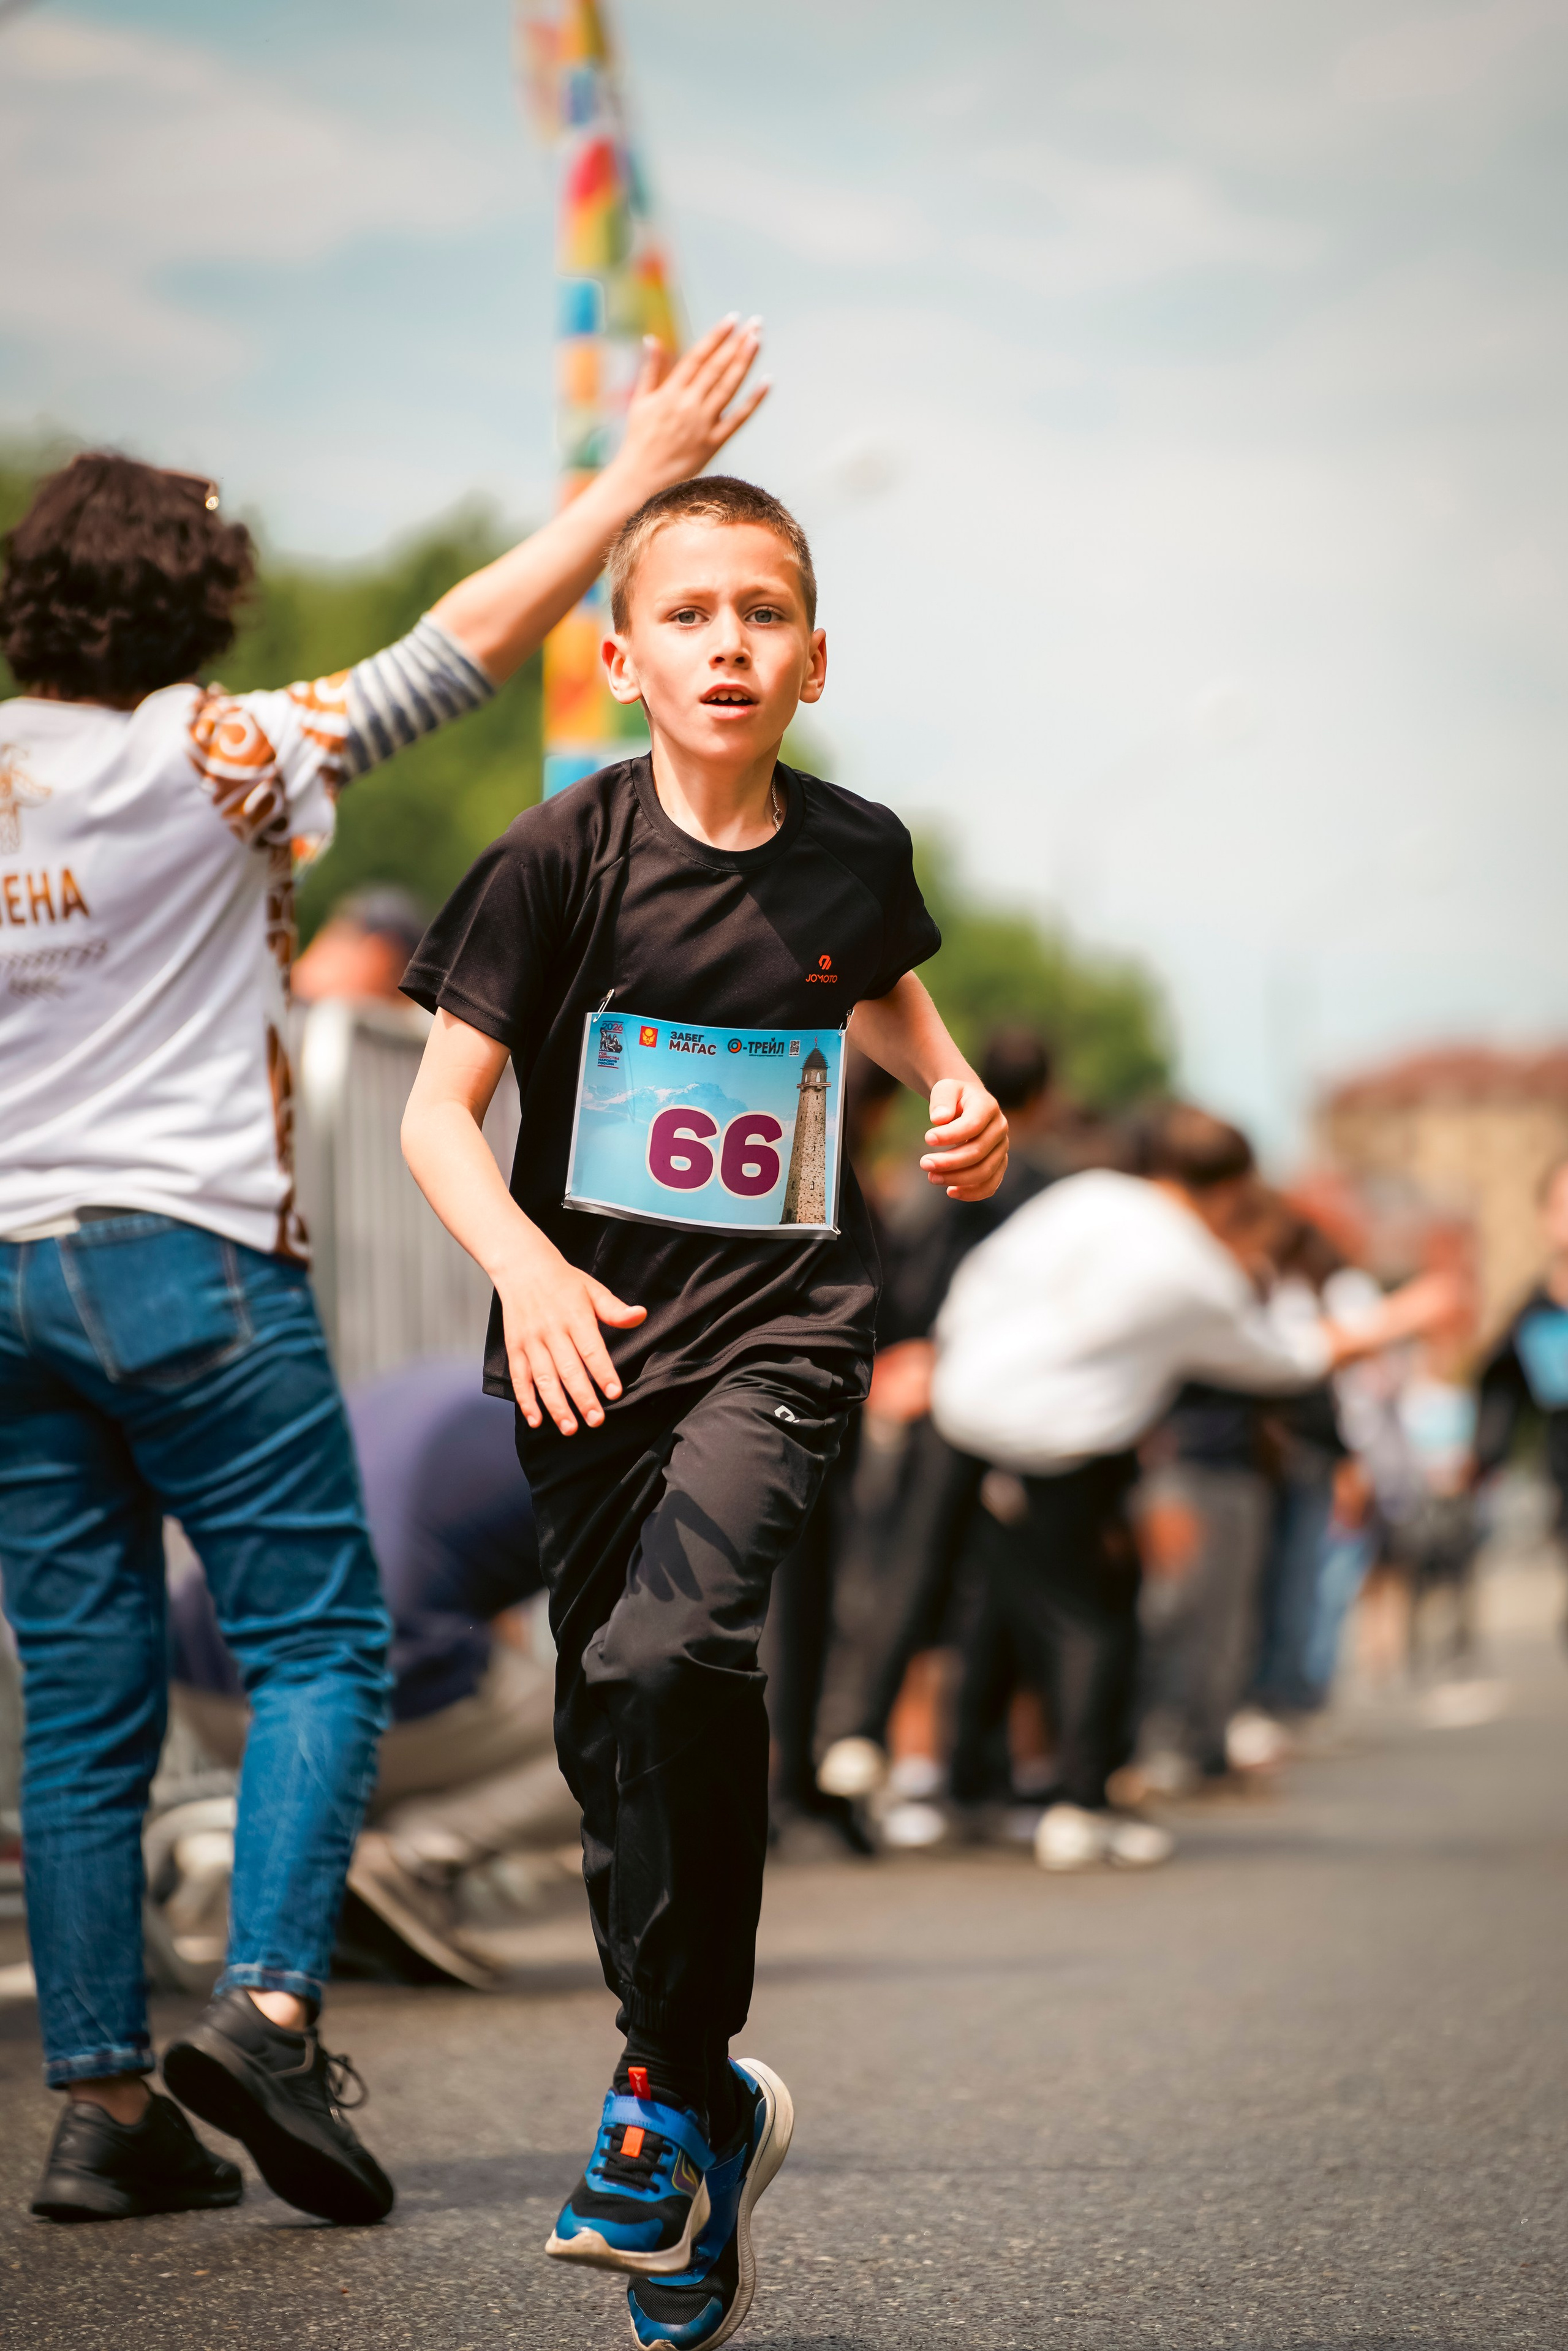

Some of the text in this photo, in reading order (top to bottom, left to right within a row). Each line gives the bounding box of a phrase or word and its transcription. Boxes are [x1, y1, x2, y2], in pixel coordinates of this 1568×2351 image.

[0, 868, 90, 927] ЕНА
[805, 974, 837, 983] JOMOTO
[602, 1022, 624, 1032] 2026
[670, 1032, 704, 1043] ЗАБЕГ
[669, 1040, 717, 1055] МАГАС
[649, 1108, 783, 1196] 66
